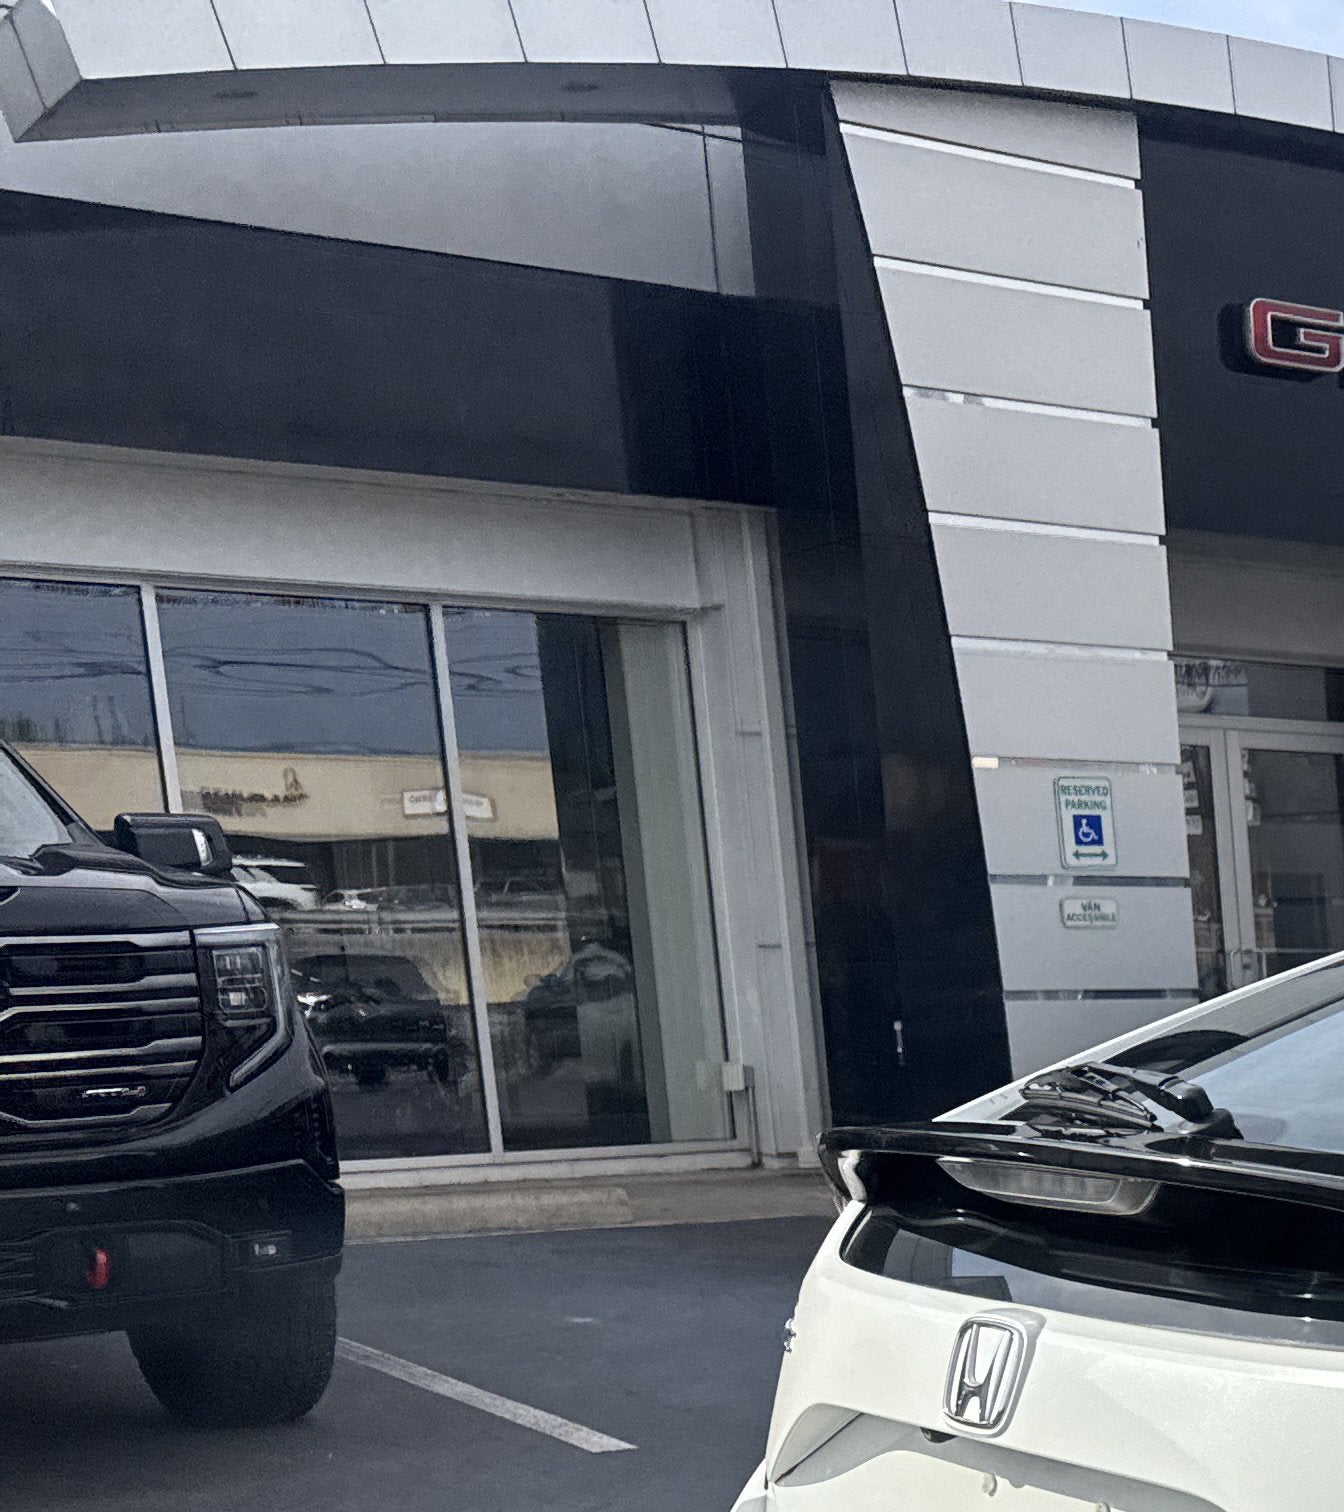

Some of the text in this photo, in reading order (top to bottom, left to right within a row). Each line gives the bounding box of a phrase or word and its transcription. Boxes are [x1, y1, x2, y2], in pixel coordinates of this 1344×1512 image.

[1060, 784, 1108, 797] RESERVED
[1065, 798, 1107, 810] PARKING
[1081, 901, 1101, 912] VAN
